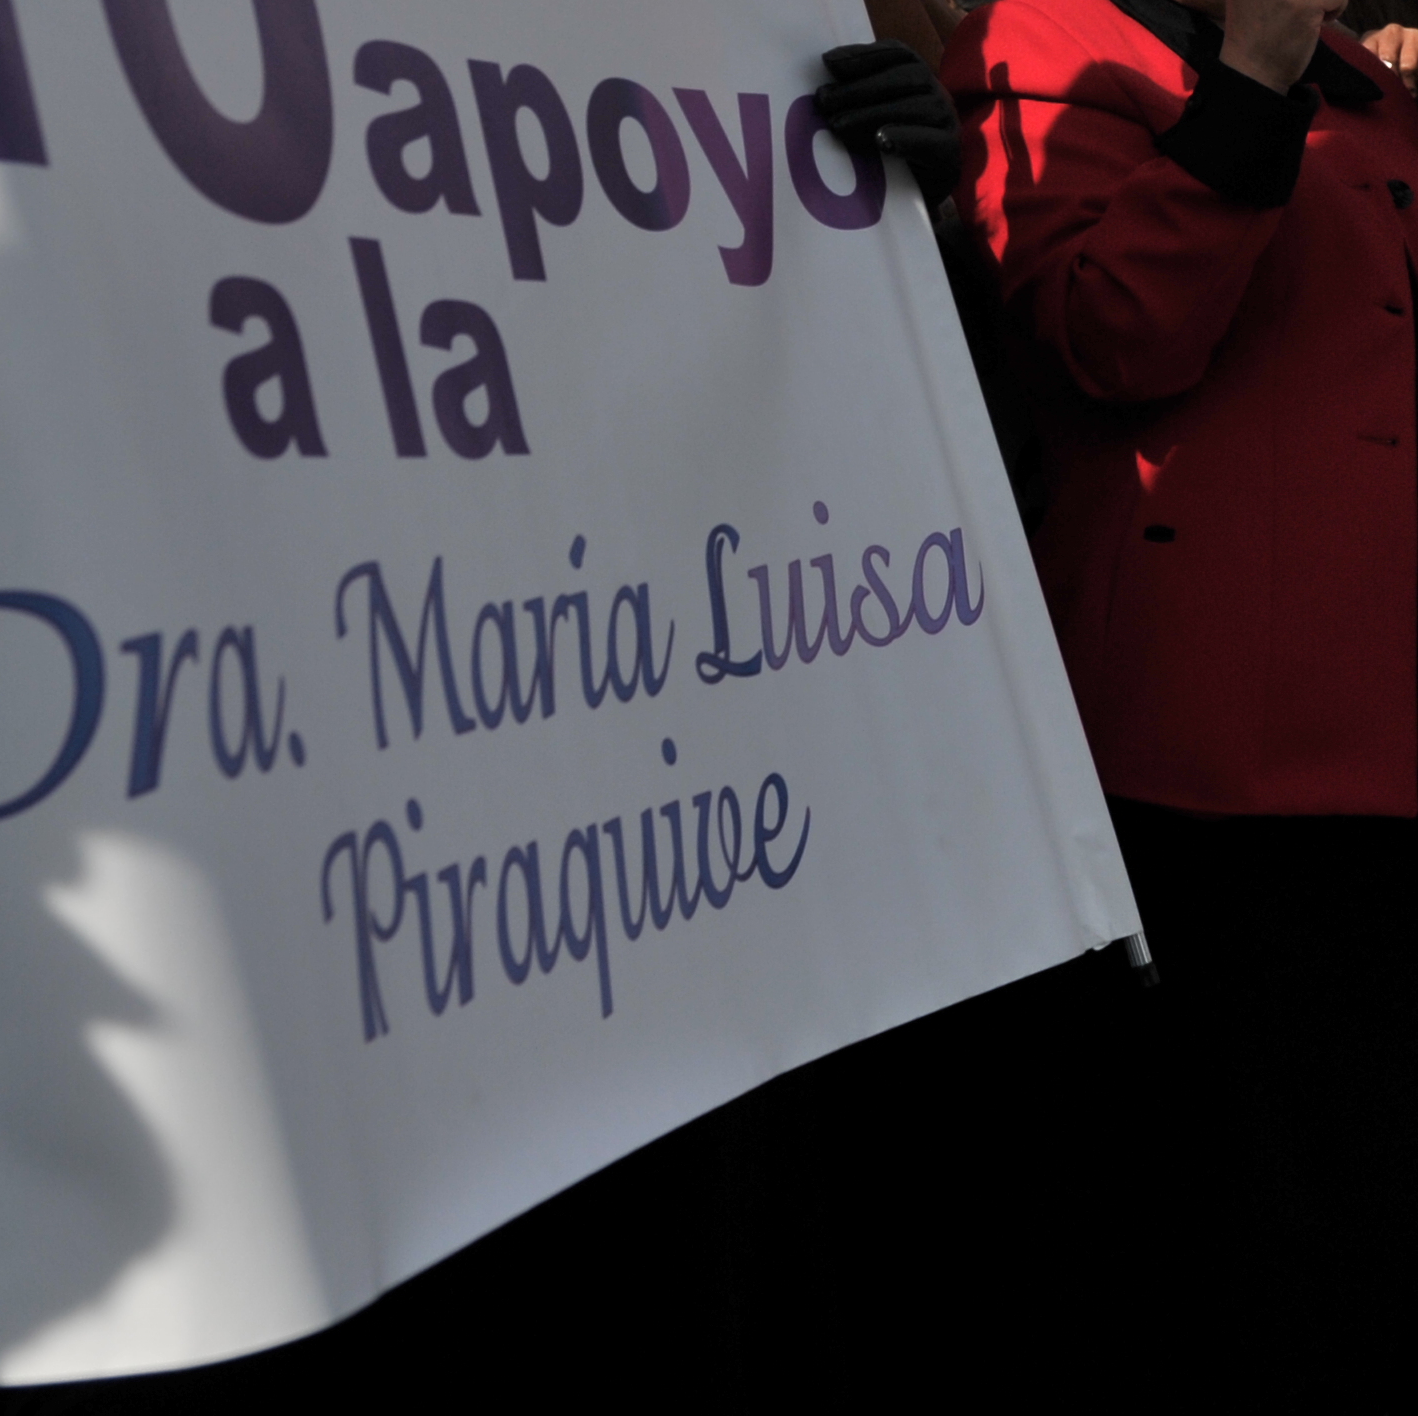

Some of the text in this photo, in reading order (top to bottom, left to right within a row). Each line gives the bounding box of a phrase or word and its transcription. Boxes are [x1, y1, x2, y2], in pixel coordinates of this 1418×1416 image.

[351, 40, 886, 288] apoyo
[207, 237, 531, 461] a la
[694, 499, 985, 685] Luisa
[321, 736, 812, 1045] Piraquive
